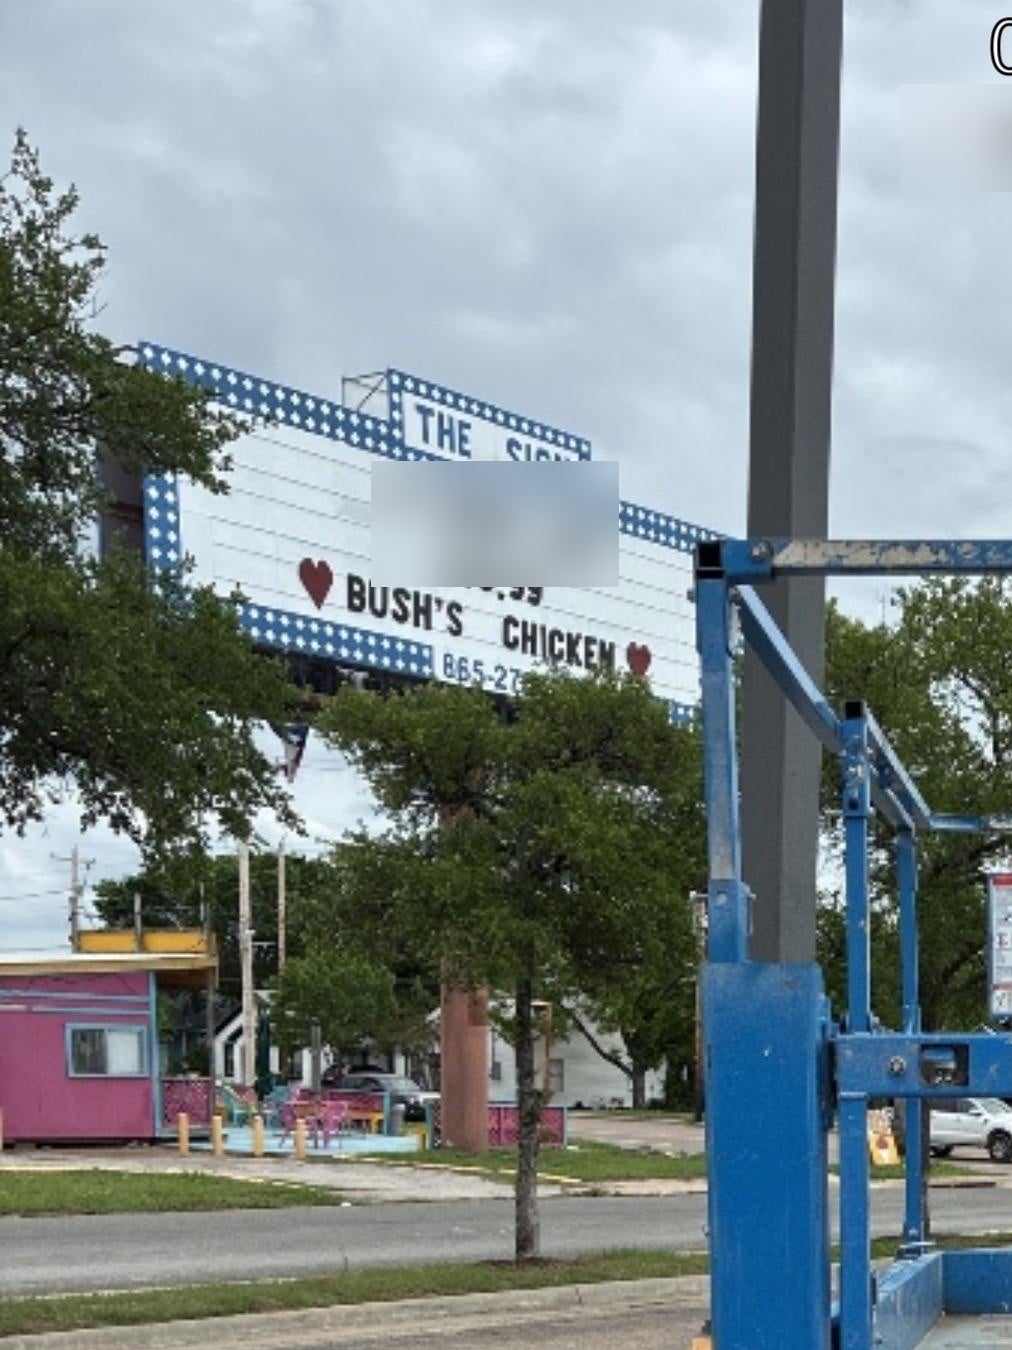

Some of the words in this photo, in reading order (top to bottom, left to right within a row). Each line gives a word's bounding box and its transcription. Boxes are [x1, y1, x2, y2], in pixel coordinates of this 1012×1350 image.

[416, 404, 472, 459] THE
[347, 572, 463, 637] BUSH'S
[503, 614, 616, 672] CHICKEN
